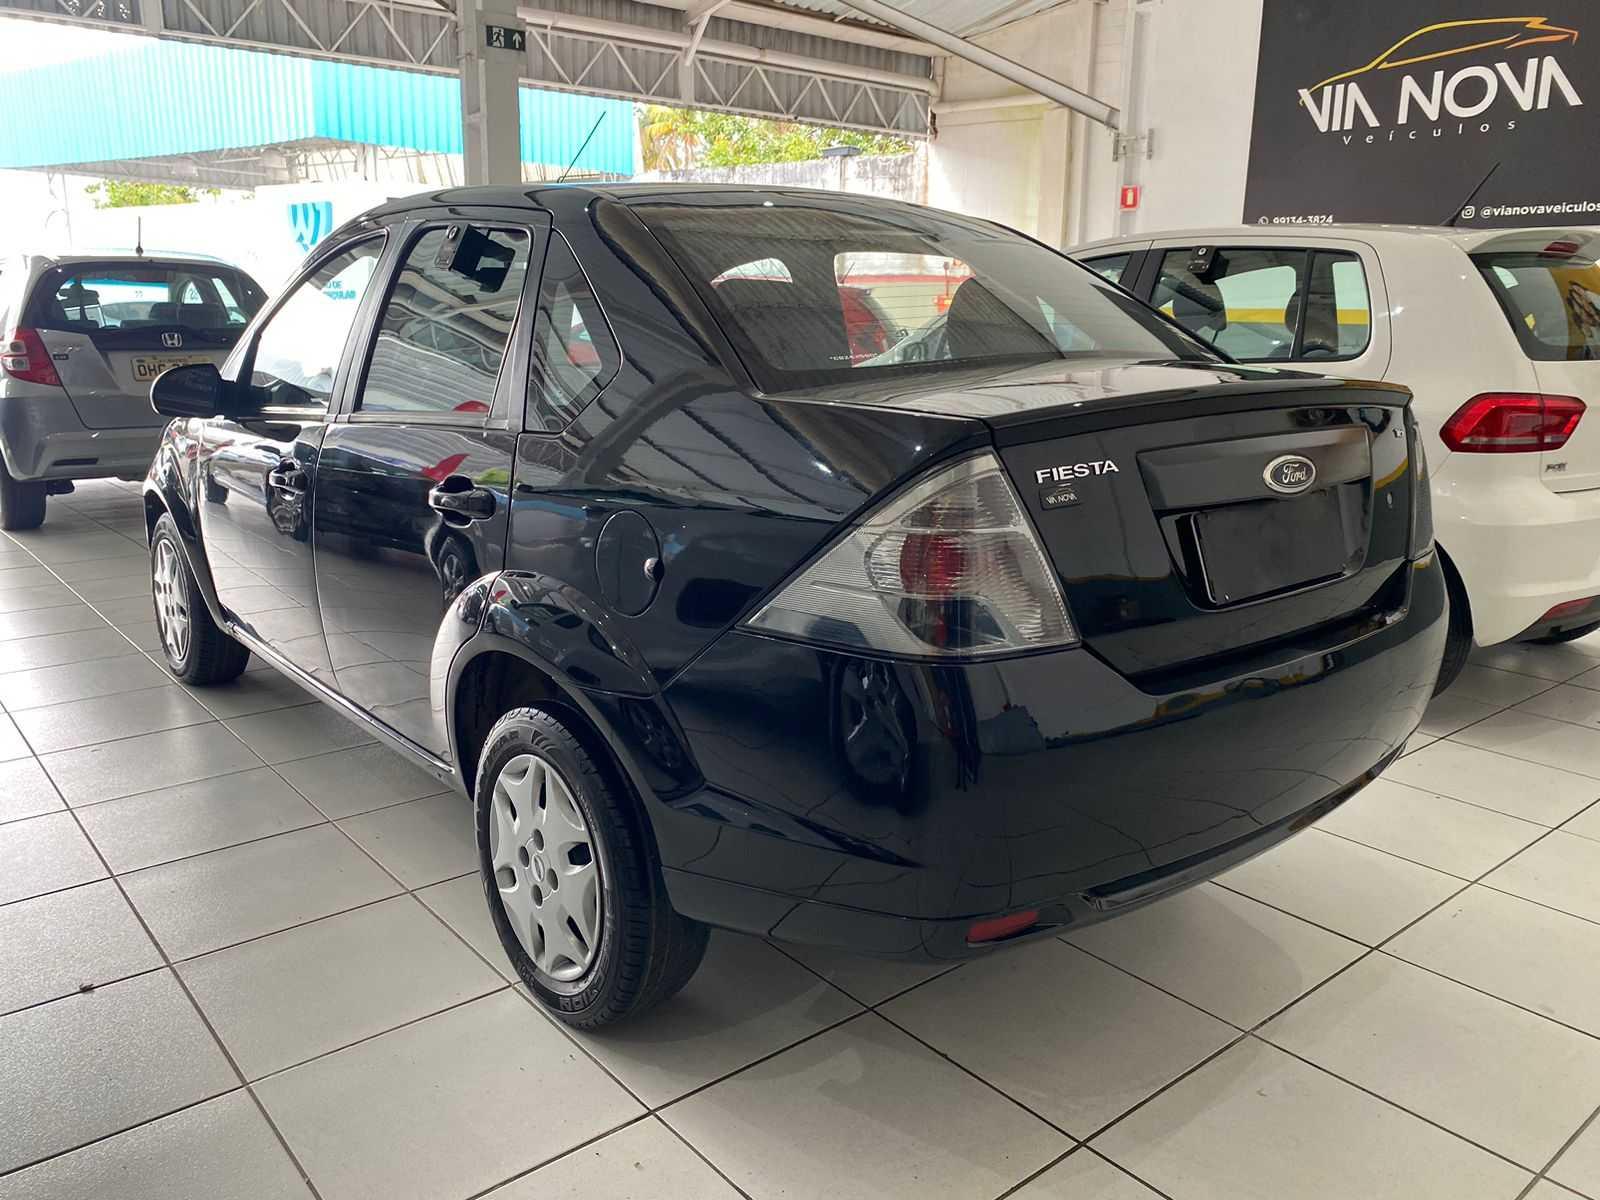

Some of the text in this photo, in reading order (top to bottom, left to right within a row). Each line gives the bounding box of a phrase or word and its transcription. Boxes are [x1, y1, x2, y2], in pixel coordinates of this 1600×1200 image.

[1297, 55, 1584, 133] VIA NOVA
[1035, 459, 1120, 484] FIESTA
[1282, 463, 1307, 484] Ford
